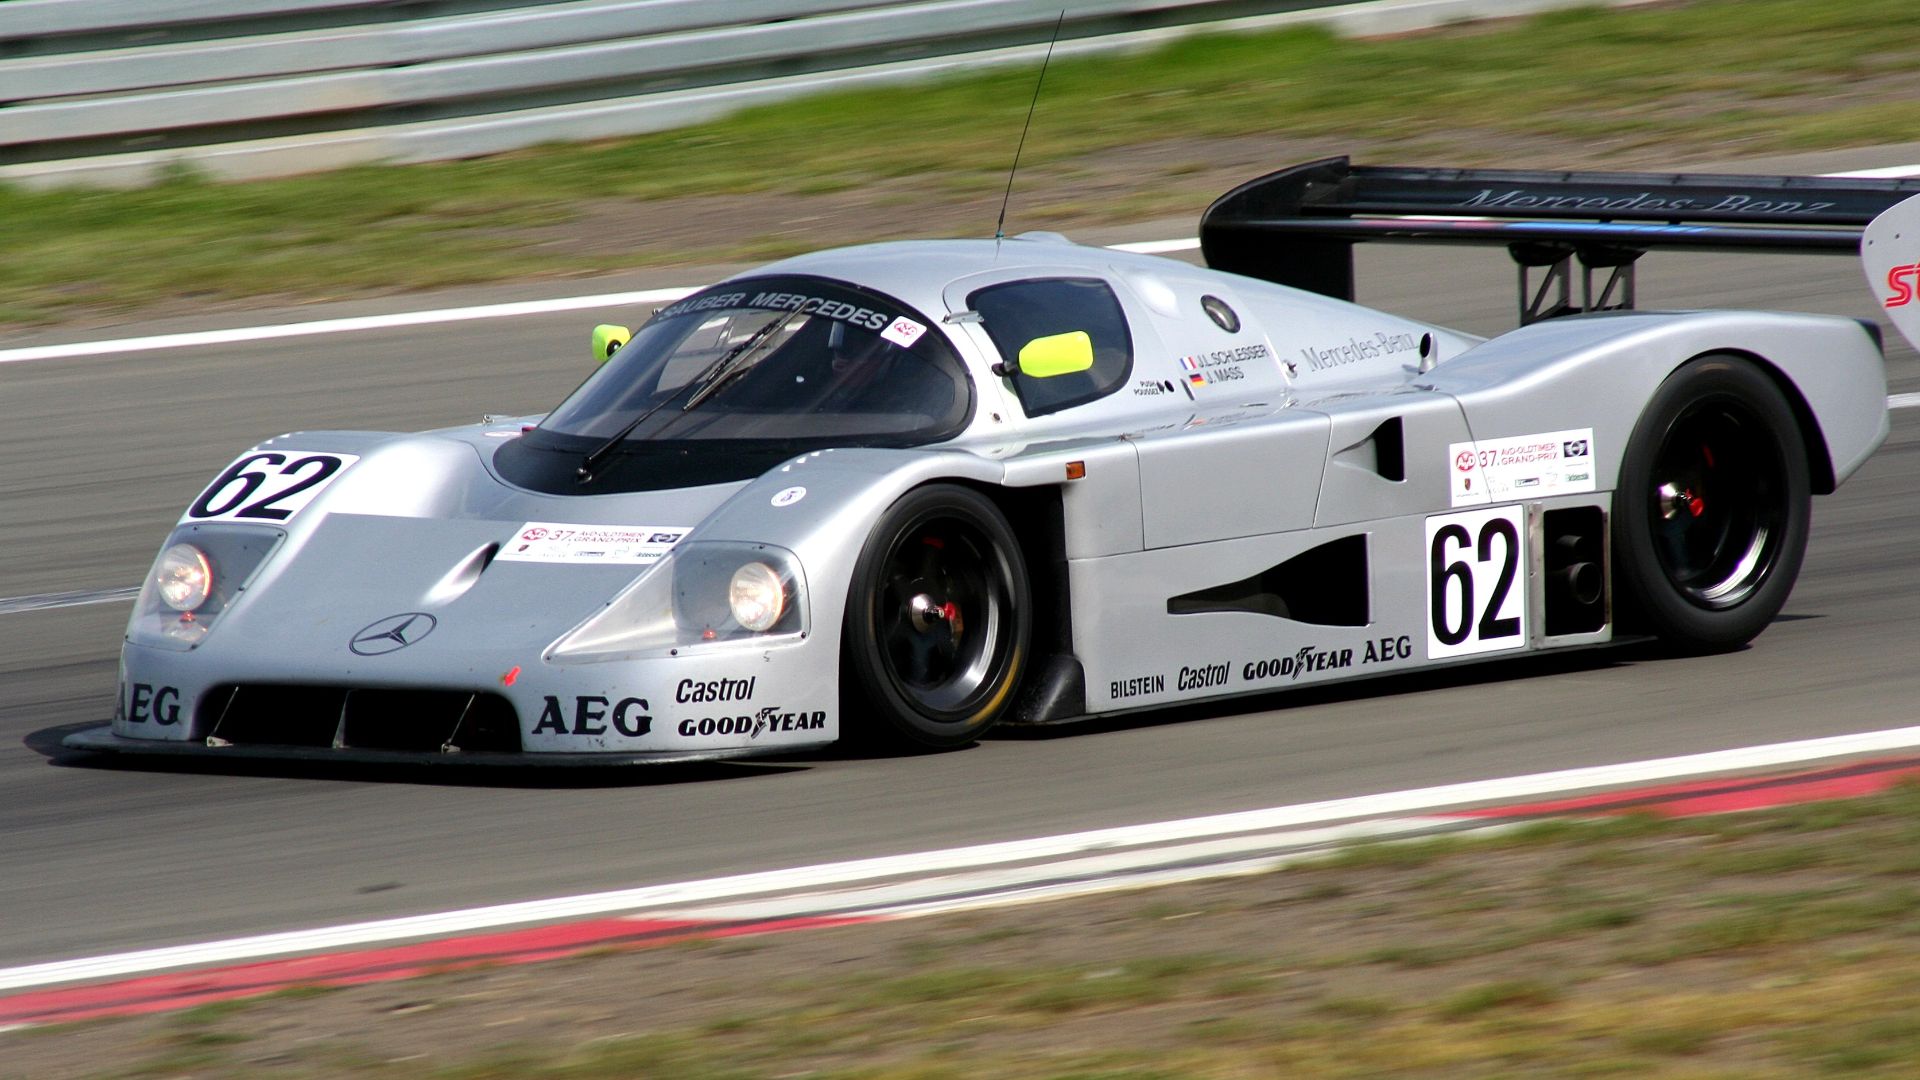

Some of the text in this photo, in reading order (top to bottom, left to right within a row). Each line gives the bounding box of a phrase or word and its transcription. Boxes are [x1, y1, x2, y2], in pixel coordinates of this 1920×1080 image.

[748, 292, 888, 330] MERCEDES
[1214, 366, 1244, 382] MASS
[1501, 452, 1558, 466] GRAND-PRIX
[189, 453, 342, 520] 62
[1431, 517, 1521, 646] 62
[1111, 674, 1165, 699] BILSTEIN
[1178, 661, 1230, 691] Castrol
[1362, 636, 1412, 664] AEG
[115, 683, 181, 726] AEG
[675, 676, 756, 704] Castrol
[531, 695, 653, 737] AEG
